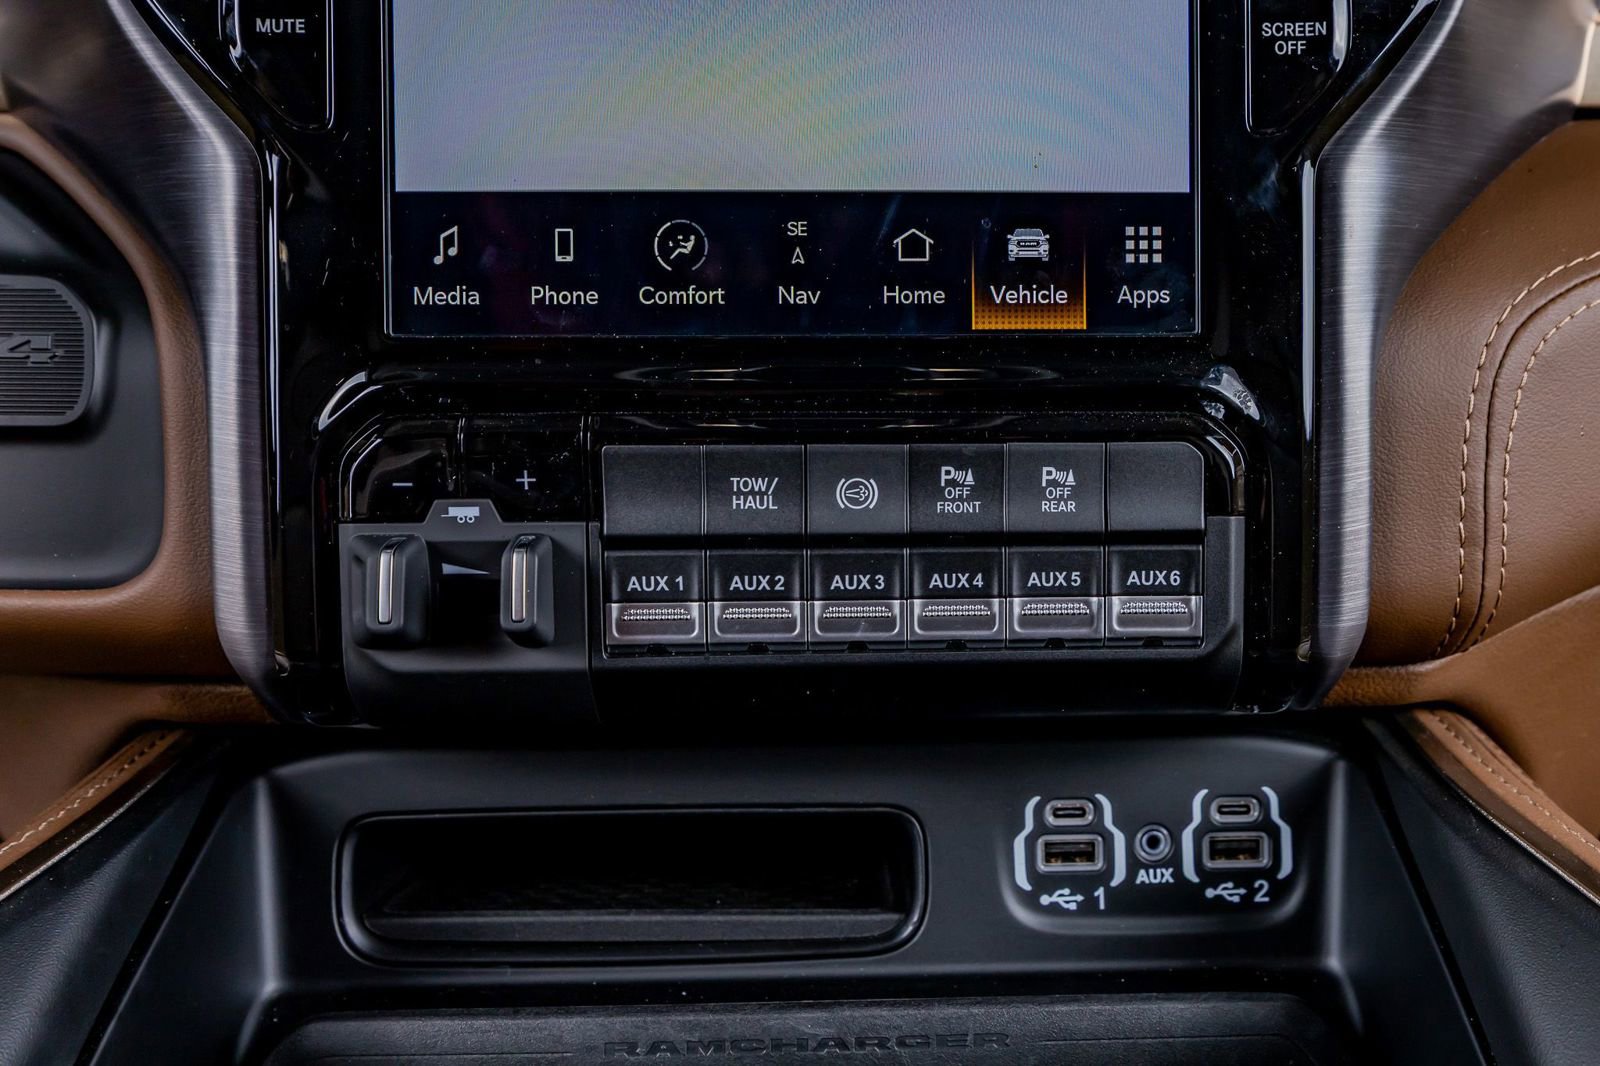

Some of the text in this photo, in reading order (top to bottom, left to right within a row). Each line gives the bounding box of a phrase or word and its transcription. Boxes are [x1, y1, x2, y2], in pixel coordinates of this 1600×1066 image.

[255, 17, 306, 34] MUTE
[1261, 22, 1327, 37] SCREEN
[1274, 40, 1307, 55] OFF
[787, 221, 808, 236] SE
[413, 285, 480, 305] Media
[531, 285, 599, 305] Phone
[639, 284, 726, 305] Comfort
[778, 285, 821, 305] Nav
[883, 285, 946, 304] Home
[990, 284, 1068, 304] Vehicle
[1117, 285, 1171, 308] Apps
[729, 477, 779, 495] TOW/
[944, 487, 971, 499] OFF
[1045, 487, 1072, 499] OFF
[732, 495, 778, 510] HAUL
[937, 501, 982, 514] FRONT
[1041, 500, 1076, 513] REAR
[626, 575, 684, 592] AUX 1
[729, 575, 785, 591] AUX 2
[830, 574, 885, 590] AUX 3
[928, 572, 984, 589] AUX 4
[1027, 571, 1081, 587] AUX 5
[1126, 570, 1181, 586] AUX 6
[1135, 867, 1175, 885] AUX
[1093, 886, 1105, 910] 1
[1253, 879, 1271, 903] 2
[603, 1033, 1011, 1057] RAMCHARGER
